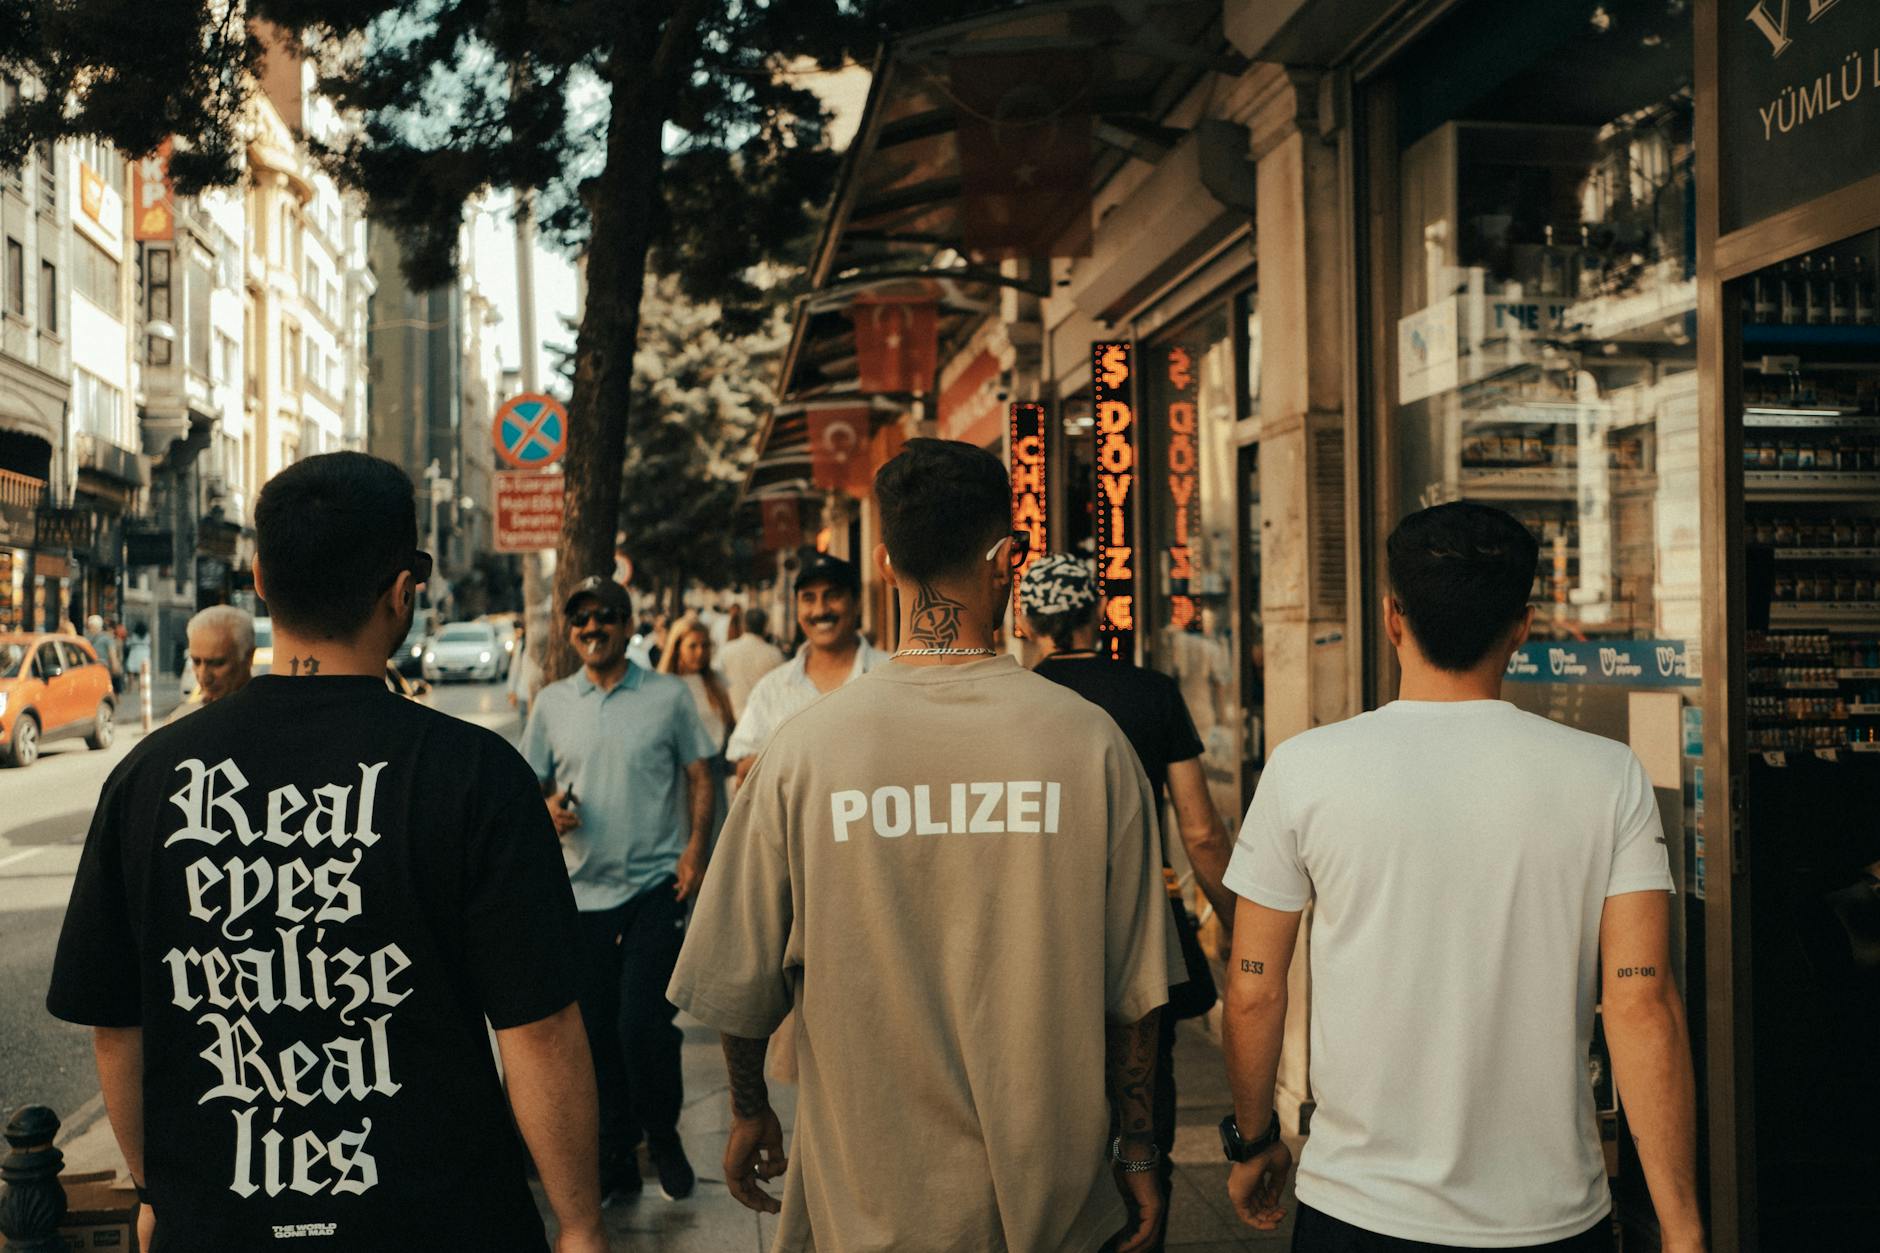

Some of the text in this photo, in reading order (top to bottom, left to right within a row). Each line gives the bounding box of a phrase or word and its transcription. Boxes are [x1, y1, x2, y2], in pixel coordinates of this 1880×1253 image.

[1760, 51, 1862, 141] YÜMLÜ
[164, 758, 388, 848] Real
[831, 781, 1061, 842] POLIZEI
[186, 848, 362, 941] eyes
[162, 925, 413, 1027] realize
[1617, 966, 1656, 978] 00:00
[197, 1012, 402, 1106] Real
[230, 1107, 378, 1198] lies
[296, 1223, 337, 1231] WORLD
